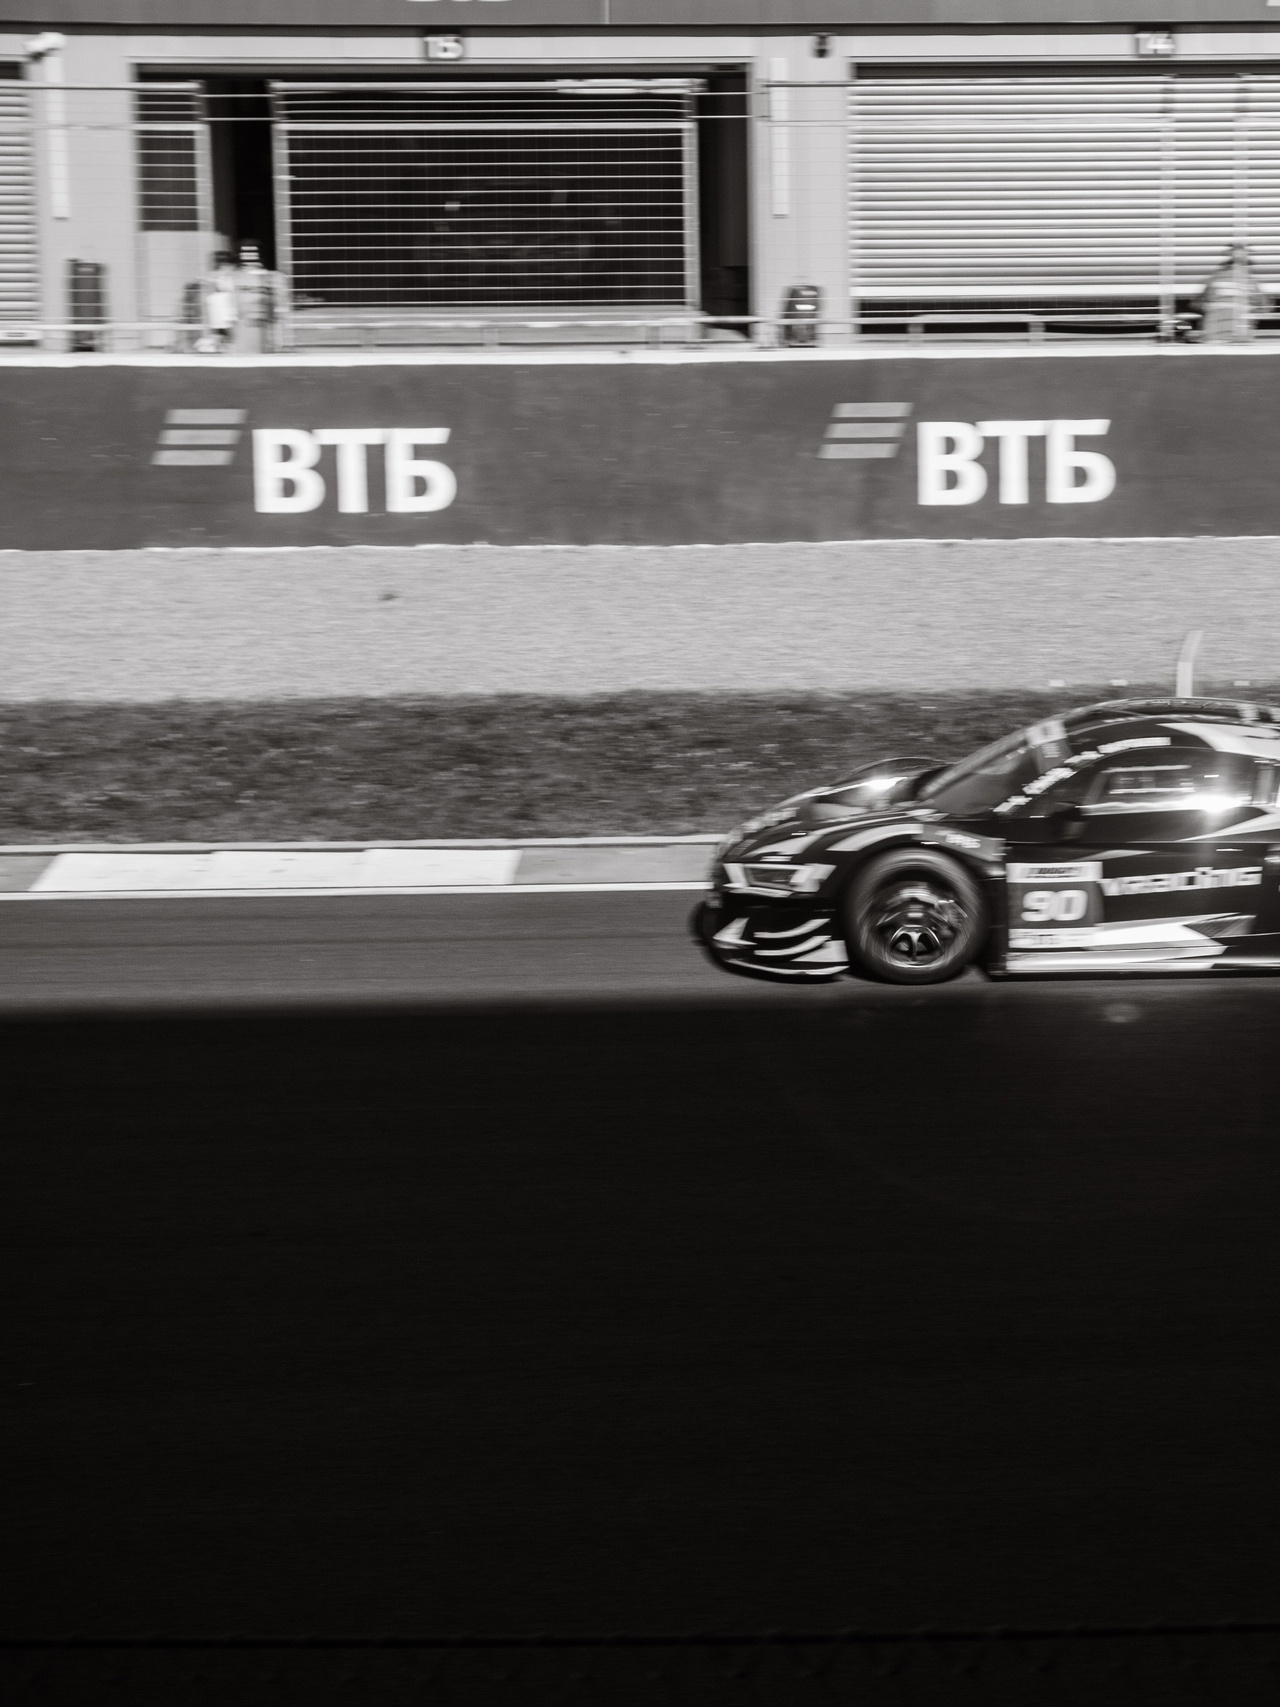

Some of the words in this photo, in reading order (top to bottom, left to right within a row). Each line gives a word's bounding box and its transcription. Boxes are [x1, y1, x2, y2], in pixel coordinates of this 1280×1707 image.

[252, 427, 457, 514] ВТБ
[917, 418, 1116, 506] ВТБ
[1021, 889, 1088, 921] 90
